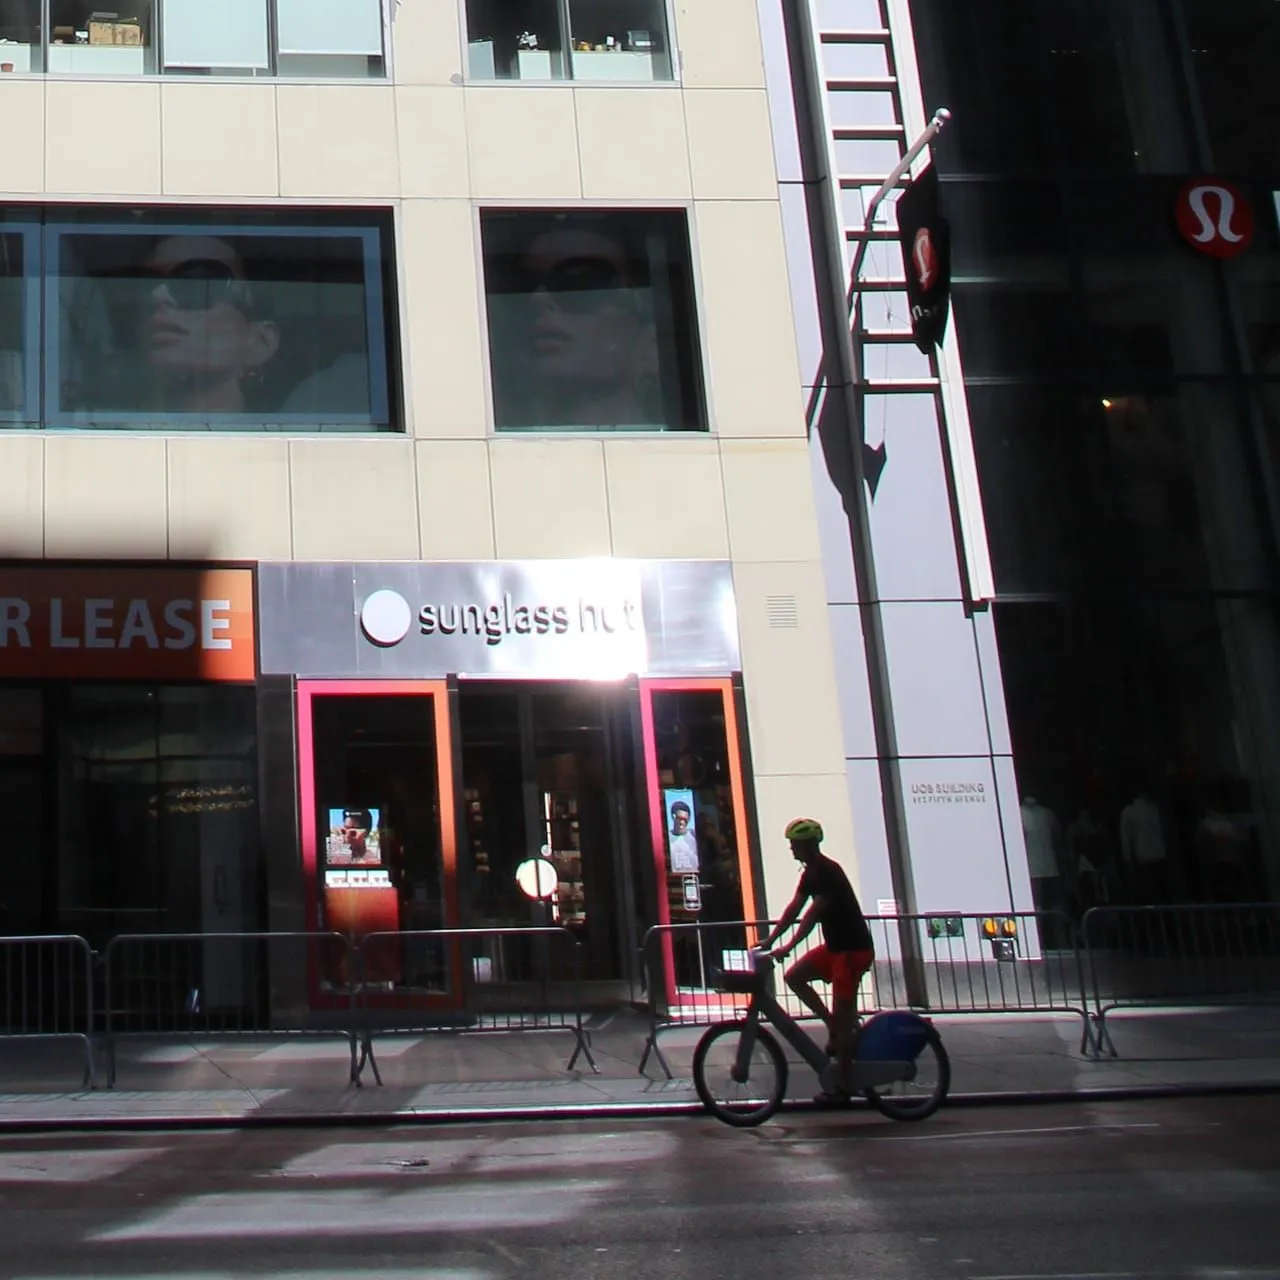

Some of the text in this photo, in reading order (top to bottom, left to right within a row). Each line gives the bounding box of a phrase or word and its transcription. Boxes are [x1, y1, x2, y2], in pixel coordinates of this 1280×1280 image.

[50, 598, 233, 650] LEASE
[417, 589, 637, 646] sunglass hut
[936, 782, 985, 794] BUILDING
